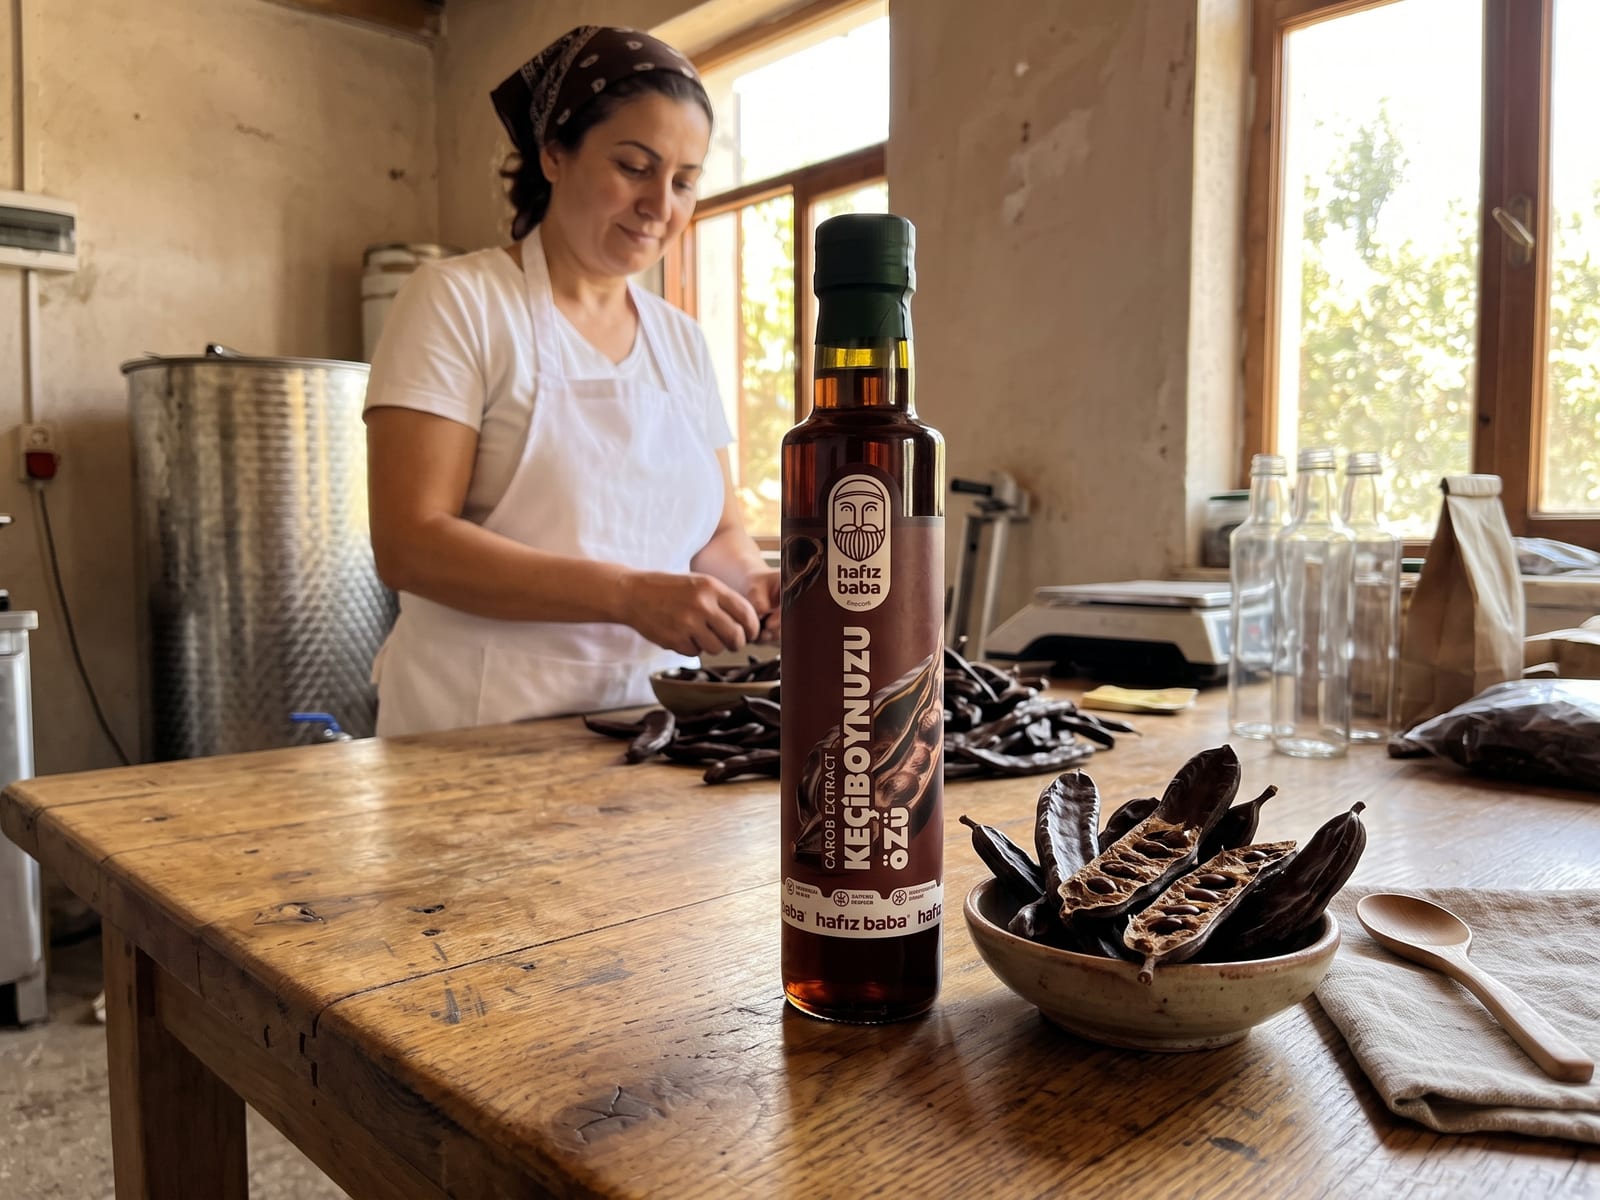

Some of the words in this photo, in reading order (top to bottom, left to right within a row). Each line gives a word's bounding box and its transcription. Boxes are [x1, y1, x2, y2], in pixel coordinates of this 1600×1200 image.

[837, 580, 881, 595] baba
[824, 819, 836, 869] CAROB
[863, 915, 907, 931] baba
